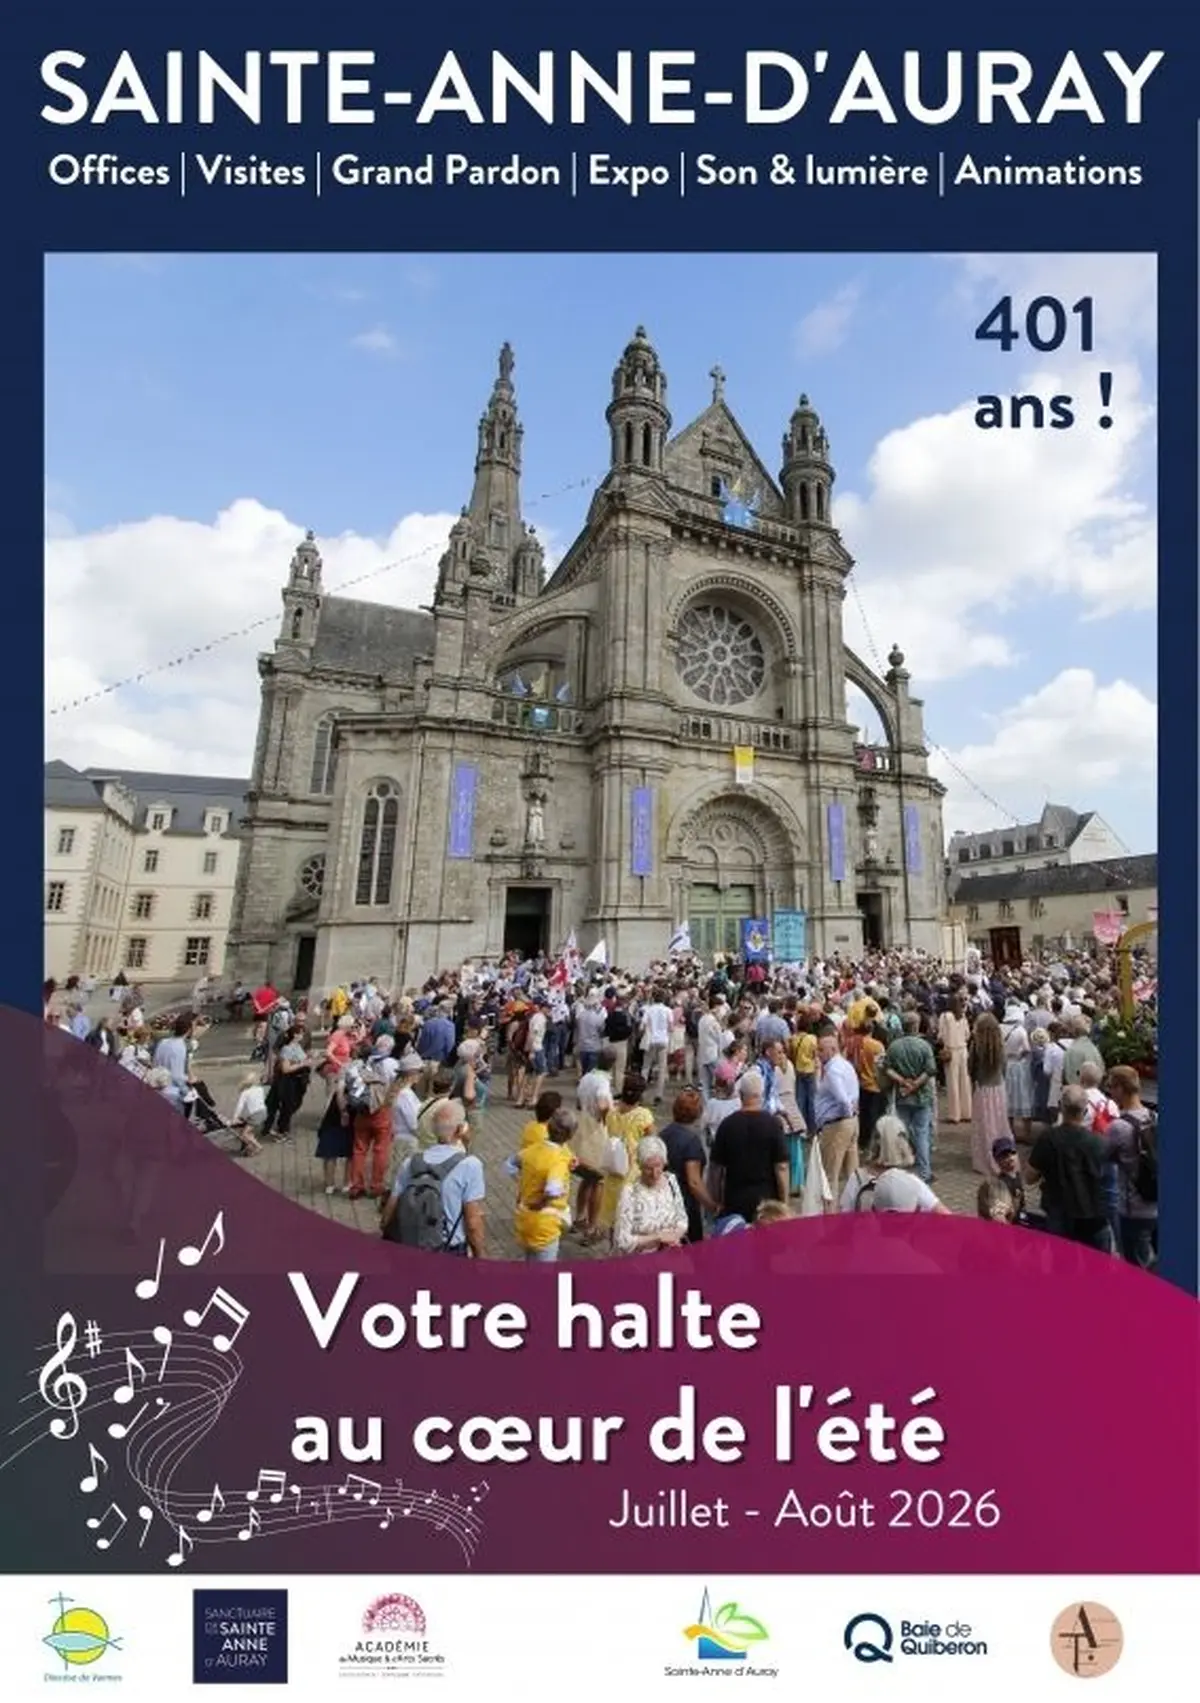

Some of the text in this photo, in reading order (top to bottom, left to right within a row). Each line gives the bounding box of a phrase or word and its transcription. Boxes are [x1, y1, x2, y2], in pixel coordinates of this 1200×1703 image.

[41, 51, 1164, 124] SAINTE-ANNE-D'AURAY
[50, 154, 169, 184] Offices
[196, 154, 305, 184] Visites
[333, 154, 432, 184] Grand
[447, 154, 559, 184] Pardon
[590, 155, 669, 196] Expo
[697, 154, 756, 184] Son
[771, 154, 795, 184] &
[807, 154, 928, 184] lumière
[955, 155, 1142, 184] Animations
[975, 296, 1092, 352] 401
[975, 395, 1074, 429] ans
[289, 1273, 759, 1348] Votre halte
[292, 1386, 943, 1461] au cœur de l'été
[610, 1490, 728, 1527] Juillet
[775, 1490, 874, 1527] Août
[889, 1490, 999, 1526] 2026
[204, 1607, 276, 1620] SANCTUAIRE
[219, 1621, 276, 1636] SAINTE
[900, 1620, 972, 1638] Baie de
[221, 1637, 268, 1651] ANNE
[355, 1640, 429, 1653] ACADÉMIE
[900, 1638, 988, 1655] Quiberon
